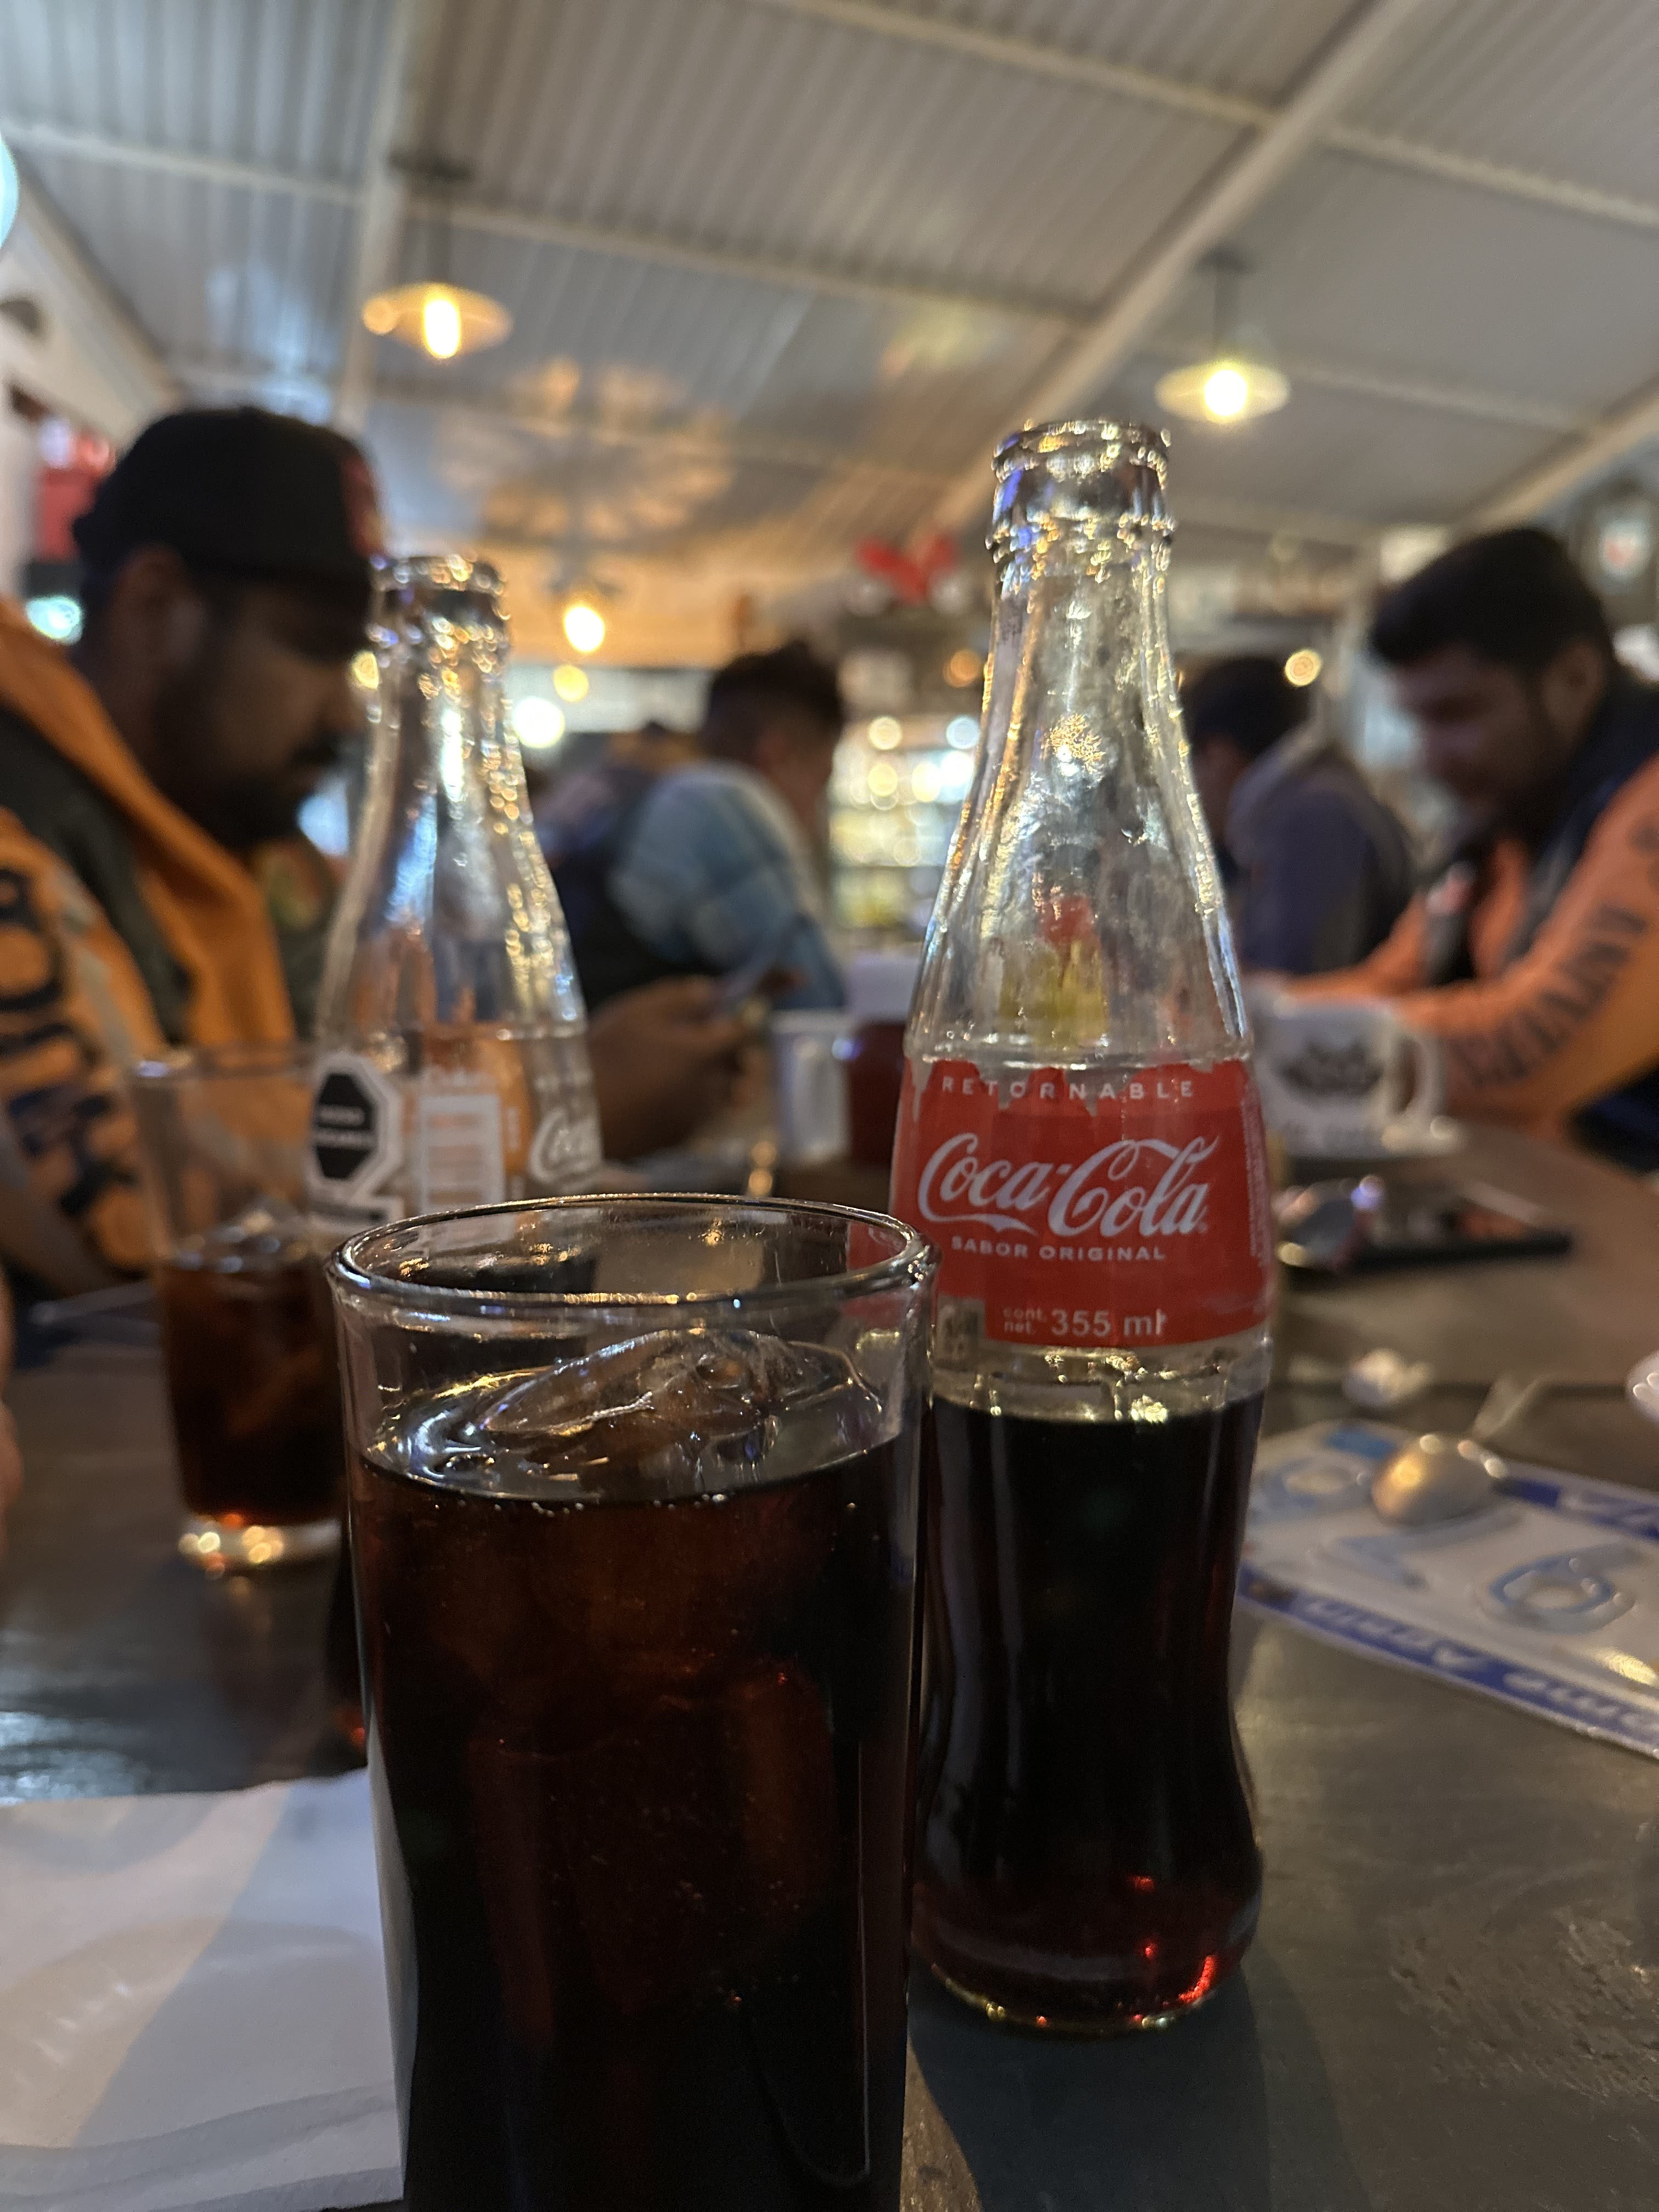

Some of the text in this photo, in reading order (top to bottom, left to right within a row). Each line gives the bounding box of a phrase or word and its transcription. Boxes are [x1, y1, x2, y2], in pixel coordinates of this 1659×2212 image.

[943, 1076, 1193, 1099] RETORNABLE
[918, 1132, 1219, 1238] Coca-Cola
[951, 1235, 1165, 1261] SABOR ORIGINAL
[1051, 1308, 1111, 1336] 355
